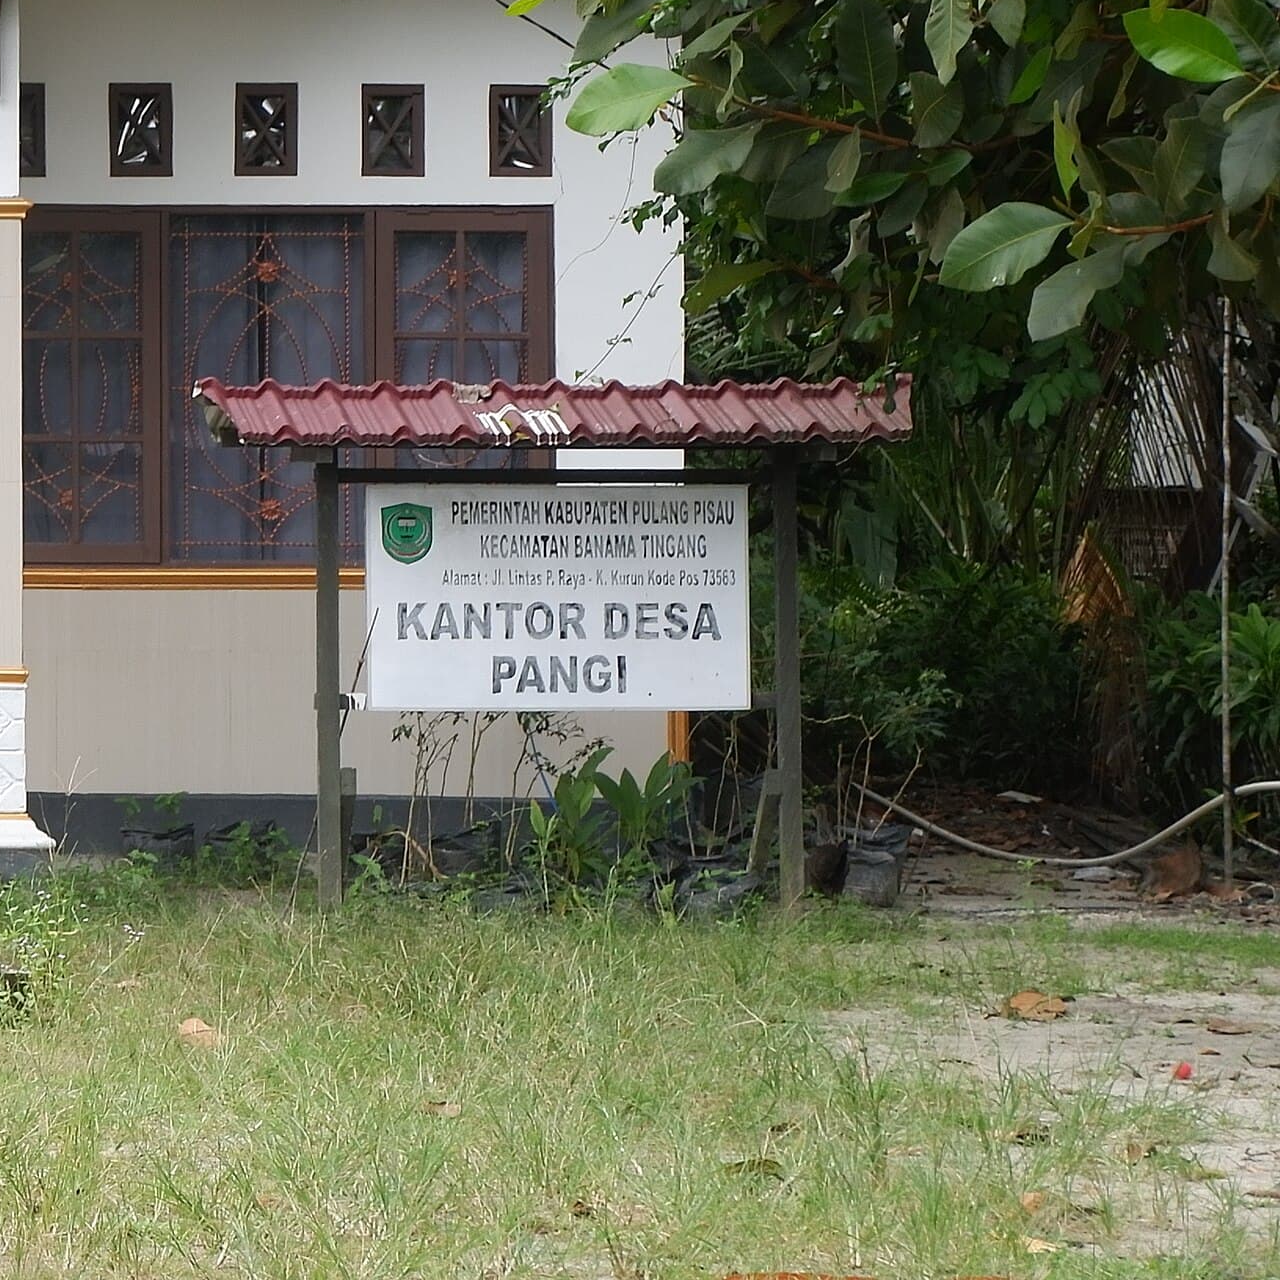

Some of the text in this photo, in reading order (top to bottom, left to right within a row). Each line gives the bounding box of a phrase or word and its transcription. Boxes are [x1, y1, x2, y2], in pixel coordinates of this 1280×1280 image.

[451, 500, 735, 525] PEMERINTAH KABUPATEN PULANG PISAU
[480, 534, 707, 559] KECAMATAN BANAMA TINGANG
[442, 569, 482, 586] Alamat
[491, 568, 504, 586] Jl.
[508, 569, 542, 586] Lintas
[546, 569, 555, 585] P.
[558, 569, 586, 590] Raya
[596, 569, 608, 586] K.
[611, 569, 644, 586] Kurun
[647, 569, 676, 586] Kode
[679, 569, 699, 586] Pos
[397, 602, 722, 641] KANTOR DESA
[491, 655, 627, 694] PANGI
